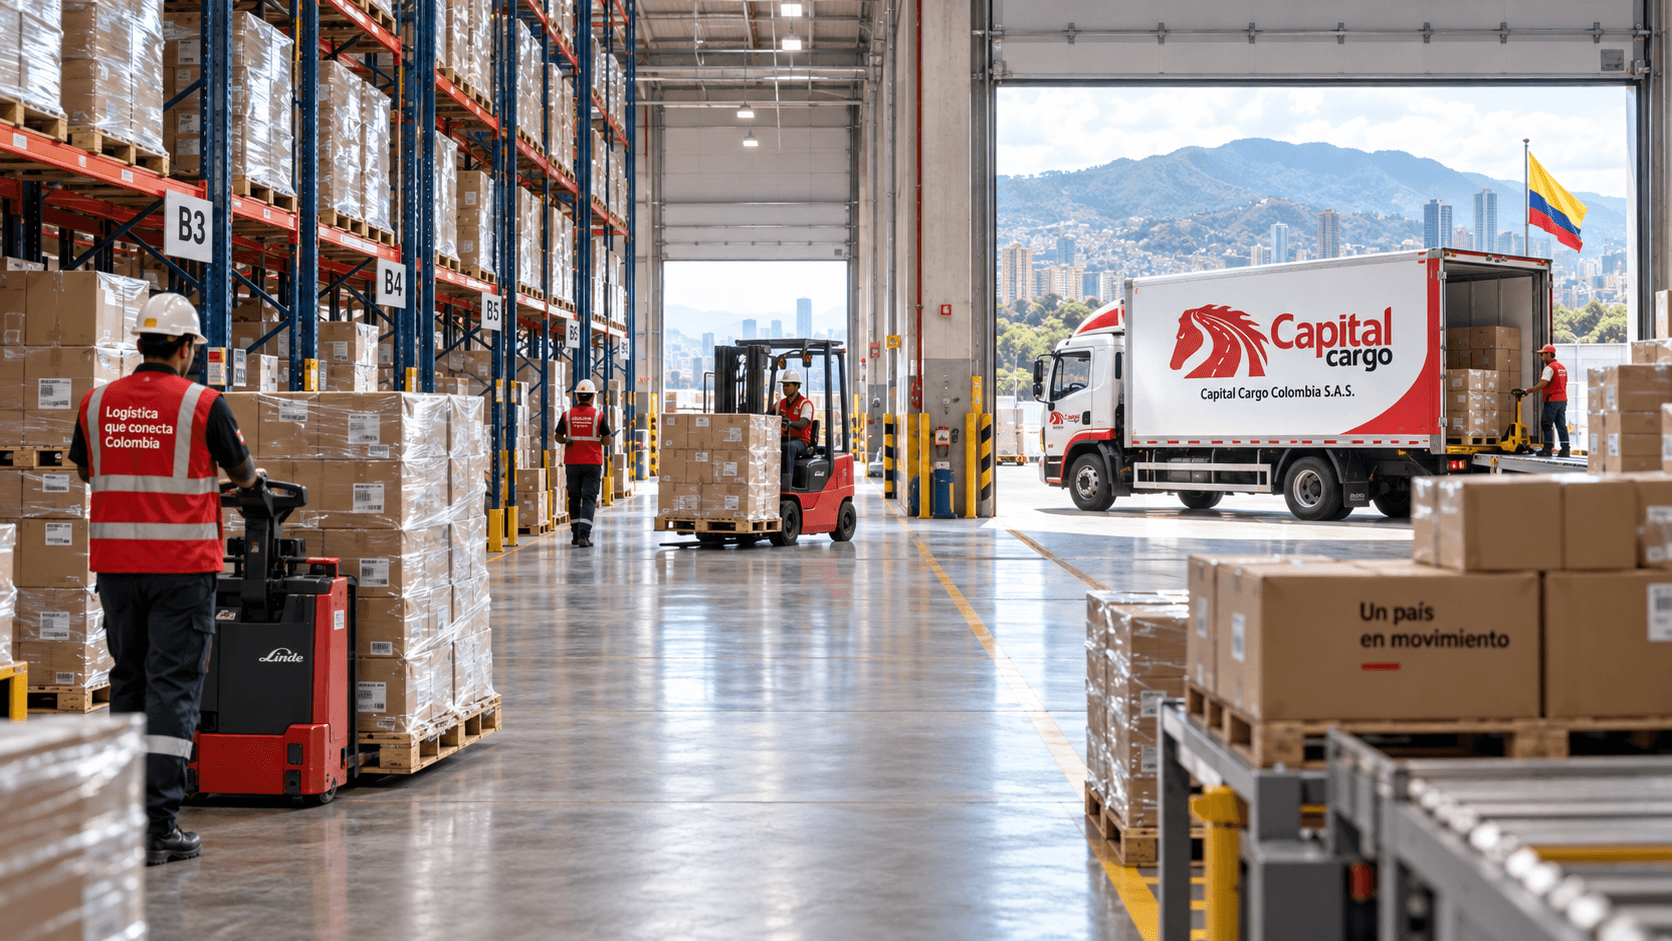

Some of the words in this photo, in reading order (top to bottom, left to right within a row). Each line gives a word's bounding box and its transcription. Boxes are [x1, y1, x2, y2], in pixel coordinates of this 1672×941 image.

[179, 205, 206, 245] B3
[385, 268, 402, 297] B4
[487, 300, 499, 321] B5
[1270, 306, 1392, 358] Capital
[1326, 347, 1393, 372] cargo
[1200, 387, 1236, 402] Capital
[1238, 386, 1269, 401] Cargo
[1271, 385, 1321, 399] Colombia
[1324, 384, 1355, 397] S.A.S.
[105, 405, 158, 421] Logística
[105, 423, 126, 435] que
[128, 423, 173, 434] conecta
[105, 436, 160, 449] Colombia
[1360, 601, 1388, 621] Un
[1393, 601, 1434, 626] país
[1360, 633, 1385, 648] en
[1391, 628, 1510, 648] movimiento
[258, 647, 304, 663] Linde
